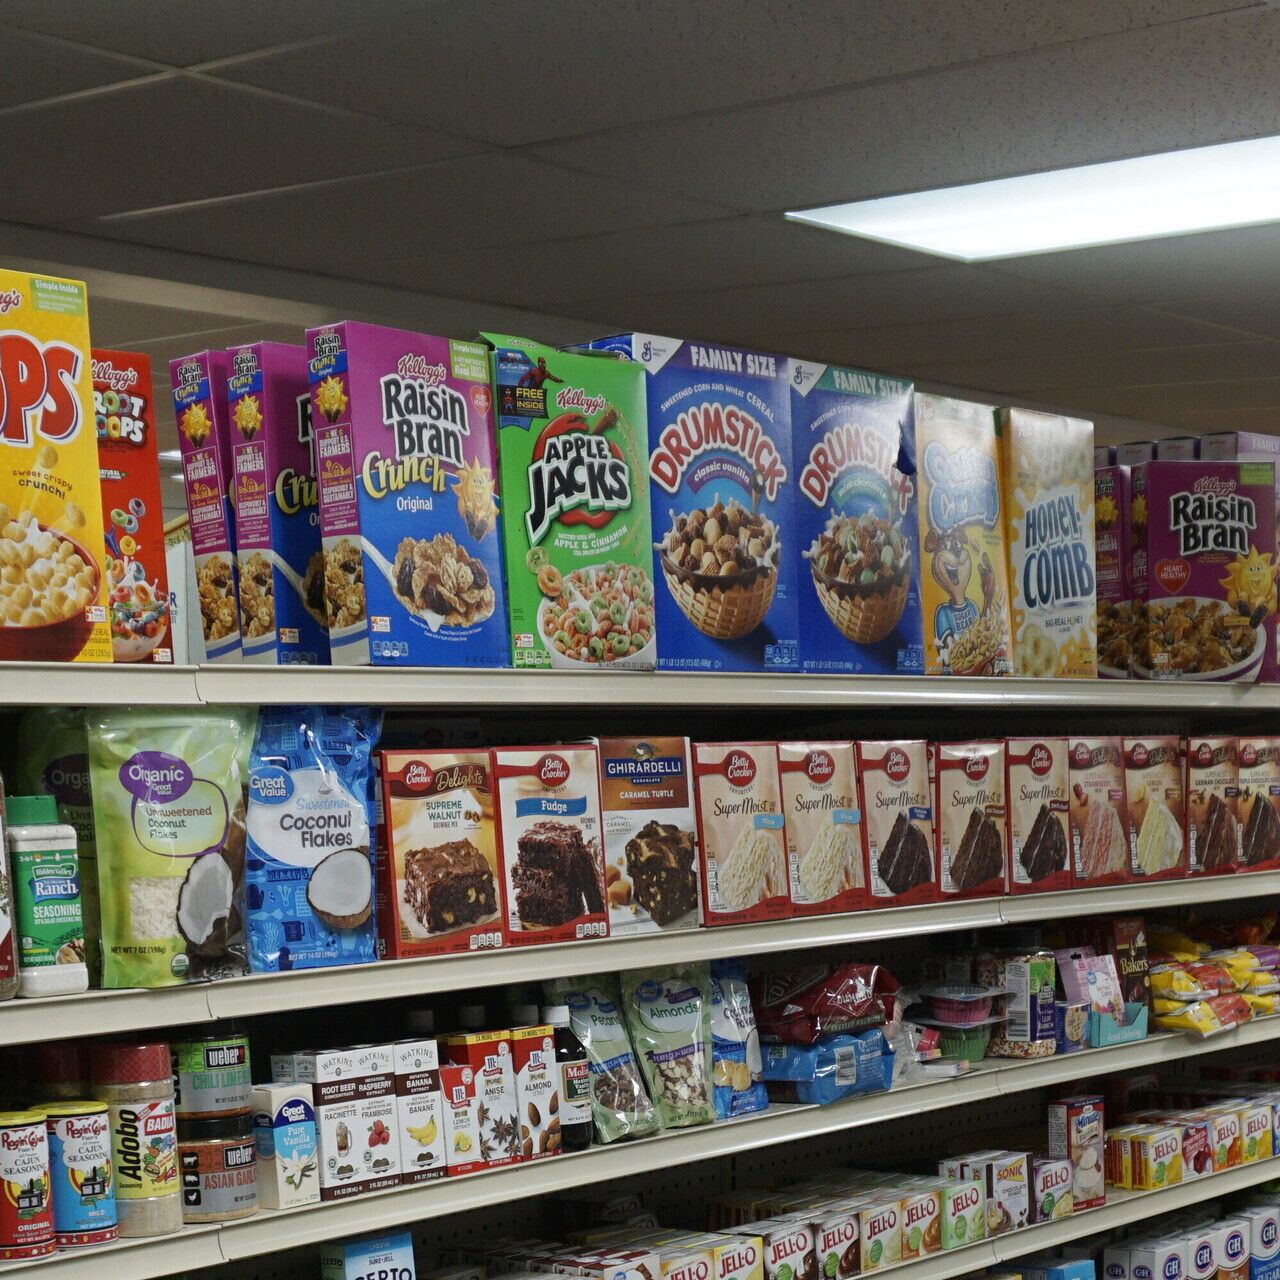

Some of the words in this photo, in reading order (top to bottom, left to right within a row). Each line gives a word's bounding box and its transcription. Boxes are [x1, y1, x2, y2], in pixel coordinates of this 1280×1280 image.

[691, 346, 743, 372] FAMILY
[747, 356, 777, 376] SIZE
[398, 354, 446, 385] Kellogg's
[516, 388, 544, 400] FREE
[556, 387, 606, 415] Kellogg's
[380, 373, 471, 435] Raisin
[516, 400, 544, 410] INSIDE
[660, 386, 693, 412] SWEETENED
[694, 383, 710, 392] CORN
[725, 384, 744, 397] WHEAT
[746, 392, 774, 423] CEREAL
[394, 417, 465, 467] Bran
[546, 432, 611, 464] APPLE
[649, 402, 787, 501] DRUMSTICK
[12, 469, 41, 478] sweet
[43, 472, 73, 489] crispy
[362, 451, 446, 498] Crunch
[693, 460, 721, 482] classic
[722, 462, 751, 484] vanilla
[18, 478, 65, 499] crunch!
[396, 496, 433, 511] Original
[526, 460, 631, 546] JACKS
[1170, 489, 1258, 532] Raisin
[554, 538, 580, 549] APPLE
[582, 540, 588, 548] &
[590, 526, 628, 548] CINNAMON
[1180, 522, 1250, 556] Bran
[1023, 541, 1094, 609] COMB
[1160, 572, 1188, 581] HEALTHY
[1162, 564, 1184, 574] HEART
[952, 612, 974, 624] SUGAR
[955, 621, 975, 632] BEAR
[541, 766, 568, 779] Crocker
[545, 758, 563, 772] Betty
[607, 762, 681, 774] GHIRARDELLI
[128, 764, 184, 782] Organic
[435, 769, 483, 791] Delights
[250, 775, 286, 789] Great
[260, 786, 287, 796] Value
[619, 790, 649, 799] CARAMEL
[651, 789, 674, 798] TURTLE
[145, 806, 212, 817] Unsweetened
[426, 800, 462, 811] SUPREME
[541, 800, 568, 812] Fudge
[428, 810, 461, 820] WALNUT
[148, 818, 187, 829] Coconut
[279, 814, 352, 832] Coconut
[149, 829, 178, 839] Flakes
[301, 829, 352, 848] Flakes
[35, 880, 77, 897] Ranch
[33, 904, 81, 918] SEASONING
[649, 1002, 699, 1020] Almonds
[209, 1048, 240, 1067] weber
[322, 1086, 337, 1095] ROOT
[338, 1083, 356, 1093] BEER
[358, 1080, 391, 1092] RASPBERRY
[406, 1078, 433, 1088] BANANA
[484, 1085, 504, 1096] ANISE
[524, 1080, 552, 1092] ALMOND
[118, 1109, 137, 1182] Adobo
[17, 1222, 50, 1232] ORIGINAL
